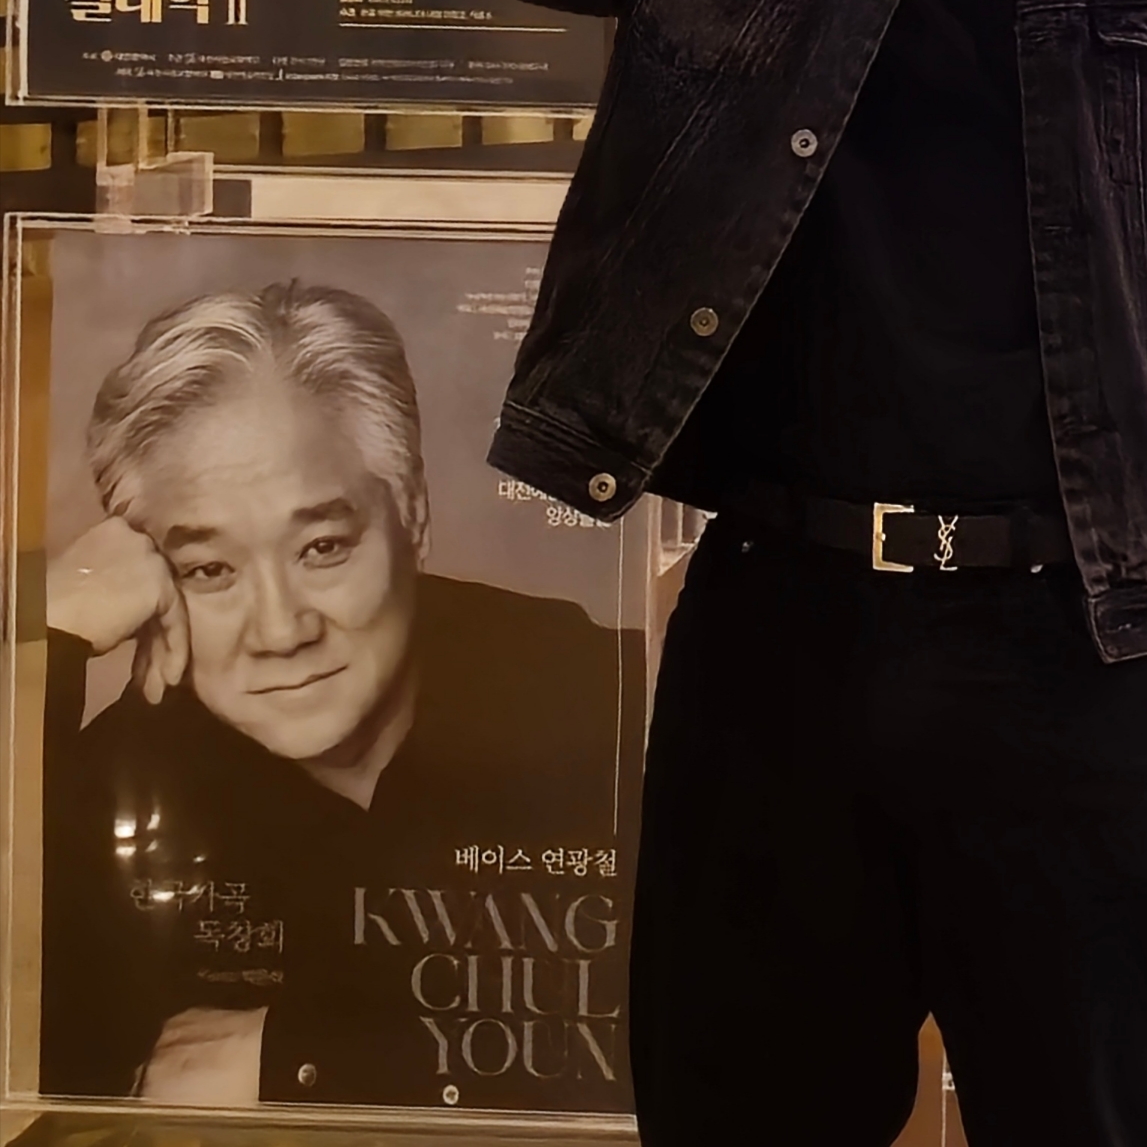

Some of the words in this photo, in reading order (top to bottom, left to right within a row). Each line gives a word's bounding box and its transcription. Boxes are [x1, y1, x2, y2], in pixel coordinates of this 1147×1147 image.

[454, 844, 533, 875] 베이스
[541, 847, 617, 877] 연광철
[193, 918, 284, 954] 독창회
[353, 886, 620, 953] KWANG
[410, 952, 621, 1019] CHUL
[418, 1015, 618, 1082] YOUN
